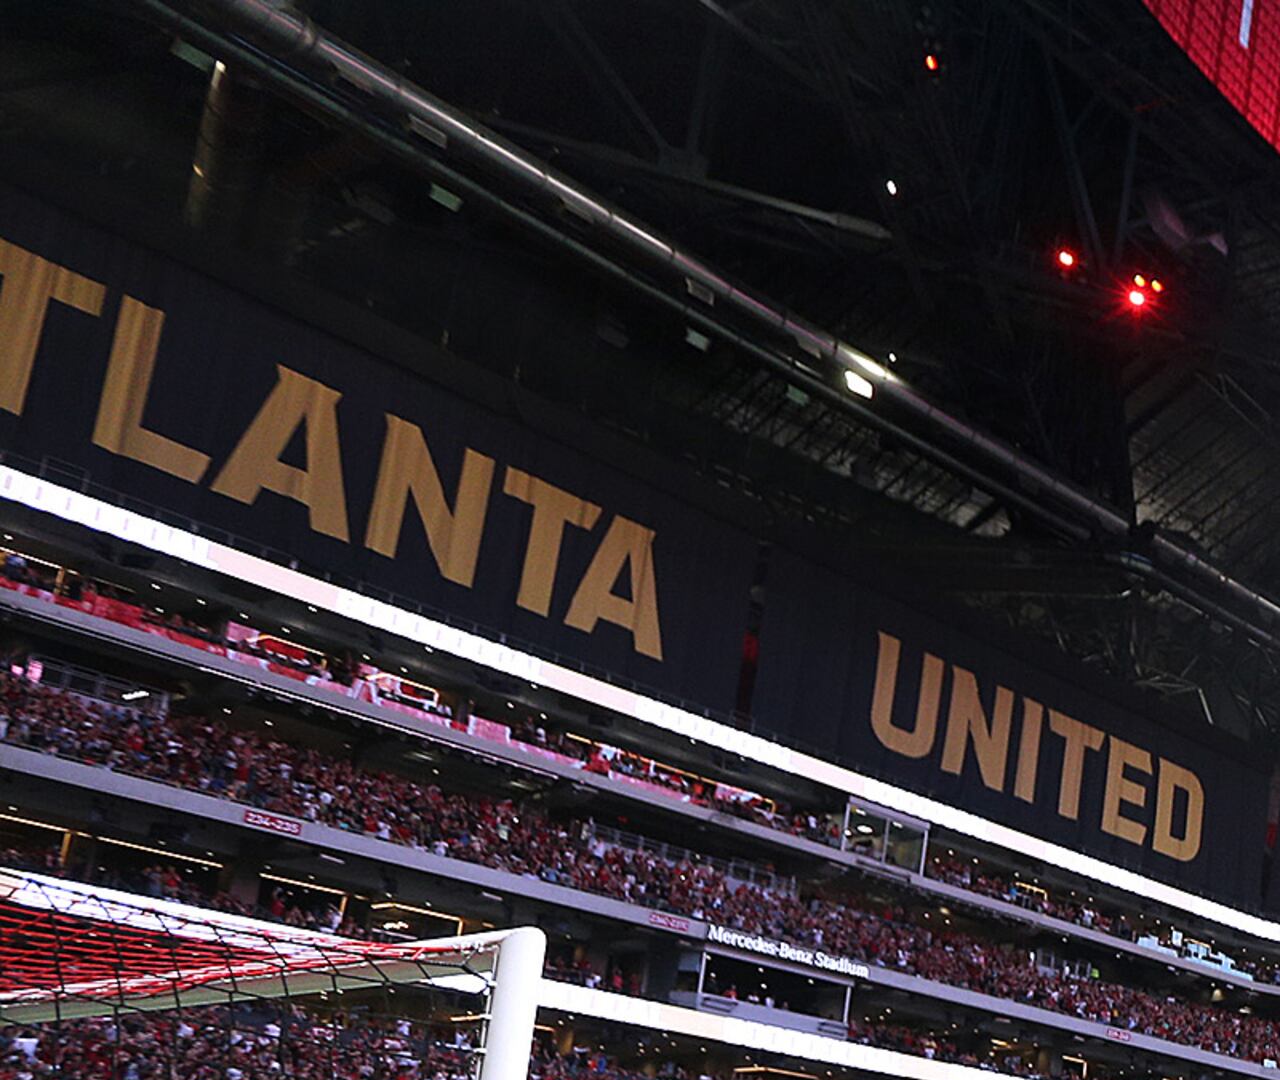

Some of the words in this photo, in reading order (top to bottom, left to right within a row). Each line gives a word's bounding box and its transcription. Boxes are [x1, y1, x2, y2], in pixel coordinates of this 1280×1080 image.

[870, 631, 1205, 862] UNITED
[708, 924, 813, 966] Mercedes-Benz
[814, 951, 869, 978] Stadium
